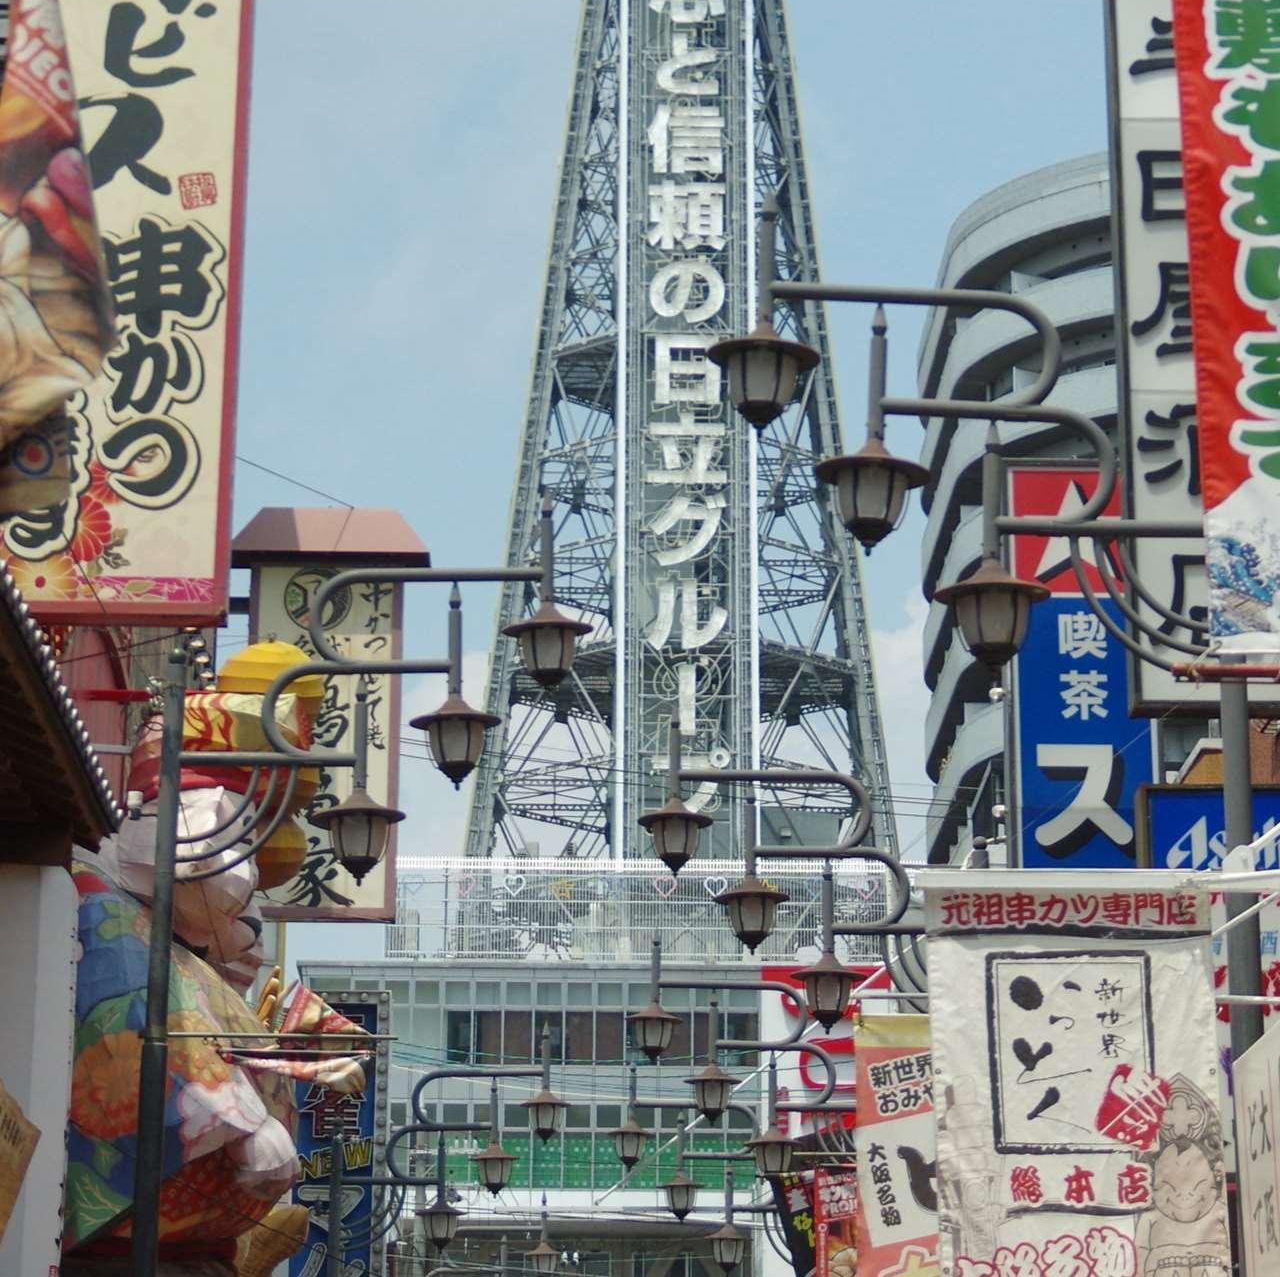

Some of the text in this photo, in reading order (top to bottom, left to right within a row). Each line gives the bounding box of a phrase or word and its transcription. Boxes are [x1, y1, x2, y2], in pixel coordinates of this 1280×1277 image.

[100, 217, 217, 498] 串かつ
[1058, 611, 1109, 721] 喫茶
[940, 891, 1198, 926] 元祖串カツ専門店
[1094, 977, 1133, 1060] 新世界
[870, 1056, 933, 1089] 新世界
[1010, 1164, 1152, 1206] 総本店
